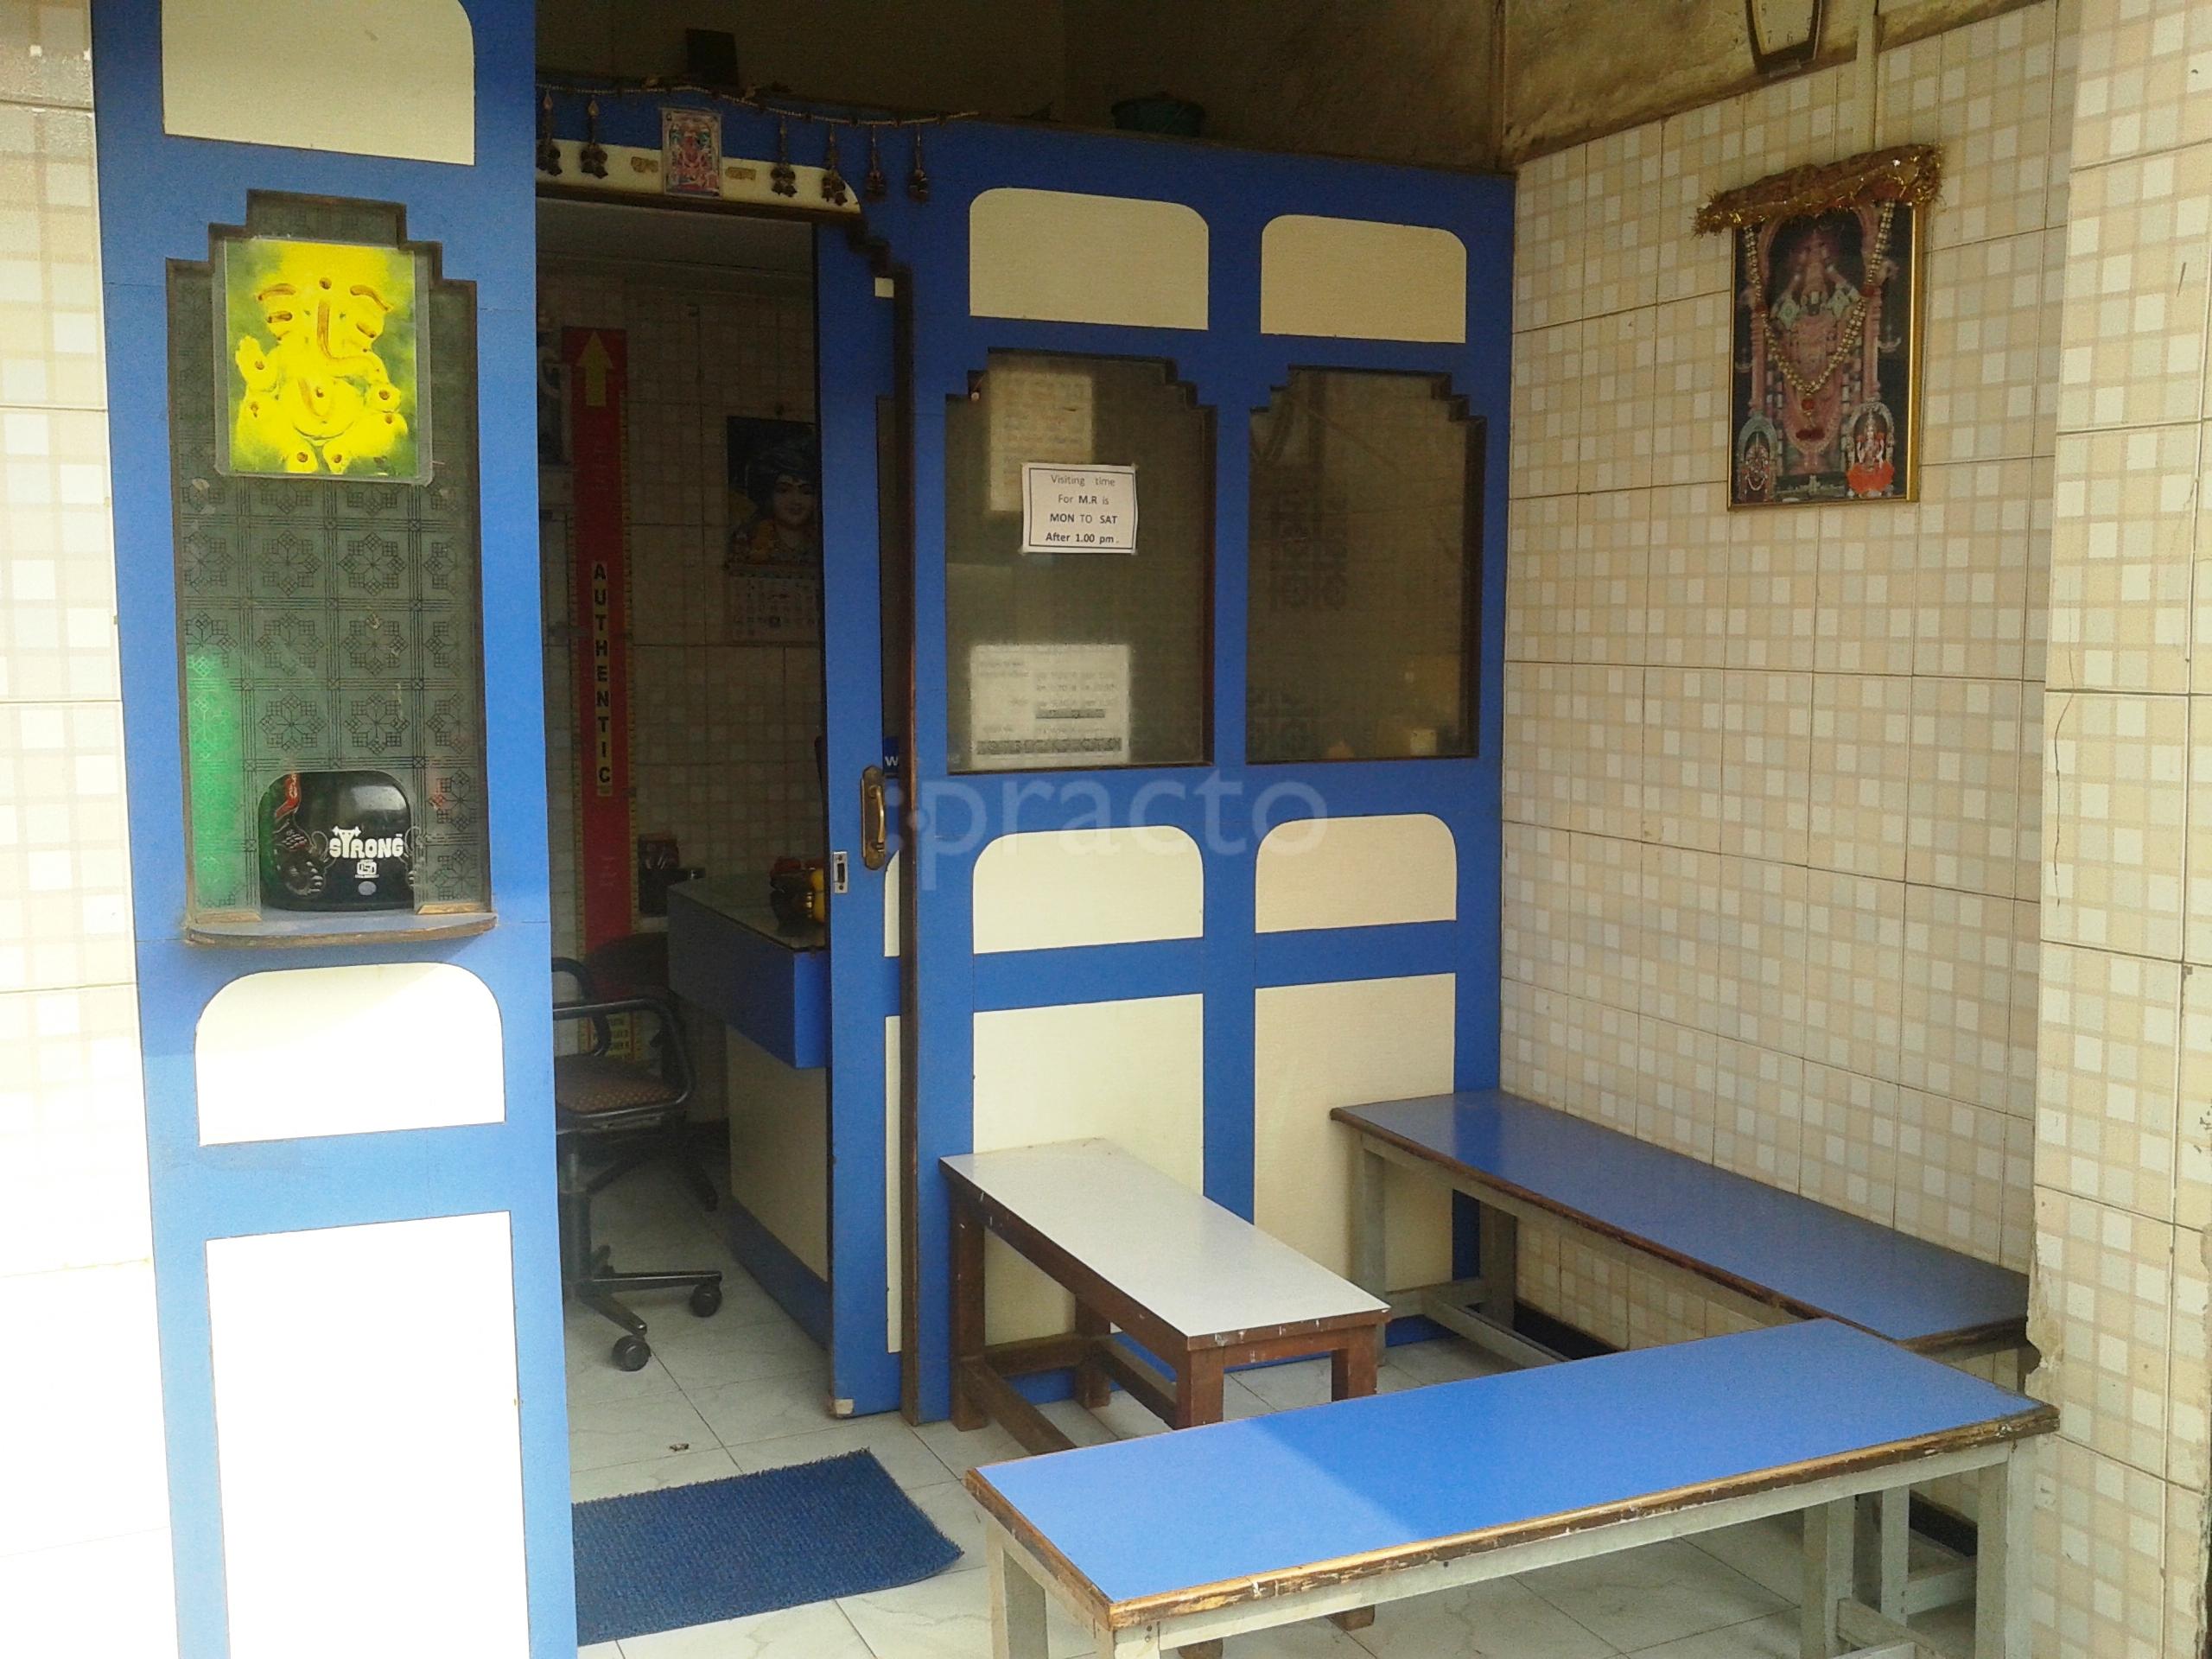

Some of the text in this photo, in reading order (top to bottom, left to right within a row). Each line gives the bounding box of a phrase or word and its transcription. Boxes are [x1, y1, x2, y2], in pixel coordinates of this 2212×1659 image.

[1051, 474, 1116, 486] Visiting time
[1058, 493, 1109, 505] For M.R is
[1050, 513, 1118, 524] MON TO SAT
[1046, 532, 1071, 542] After
[1076, 534, 1095, 543] 1.00
[593, 563, 612, 784] AUTHENTIC
[329, 825, 404, 859] STRONG
